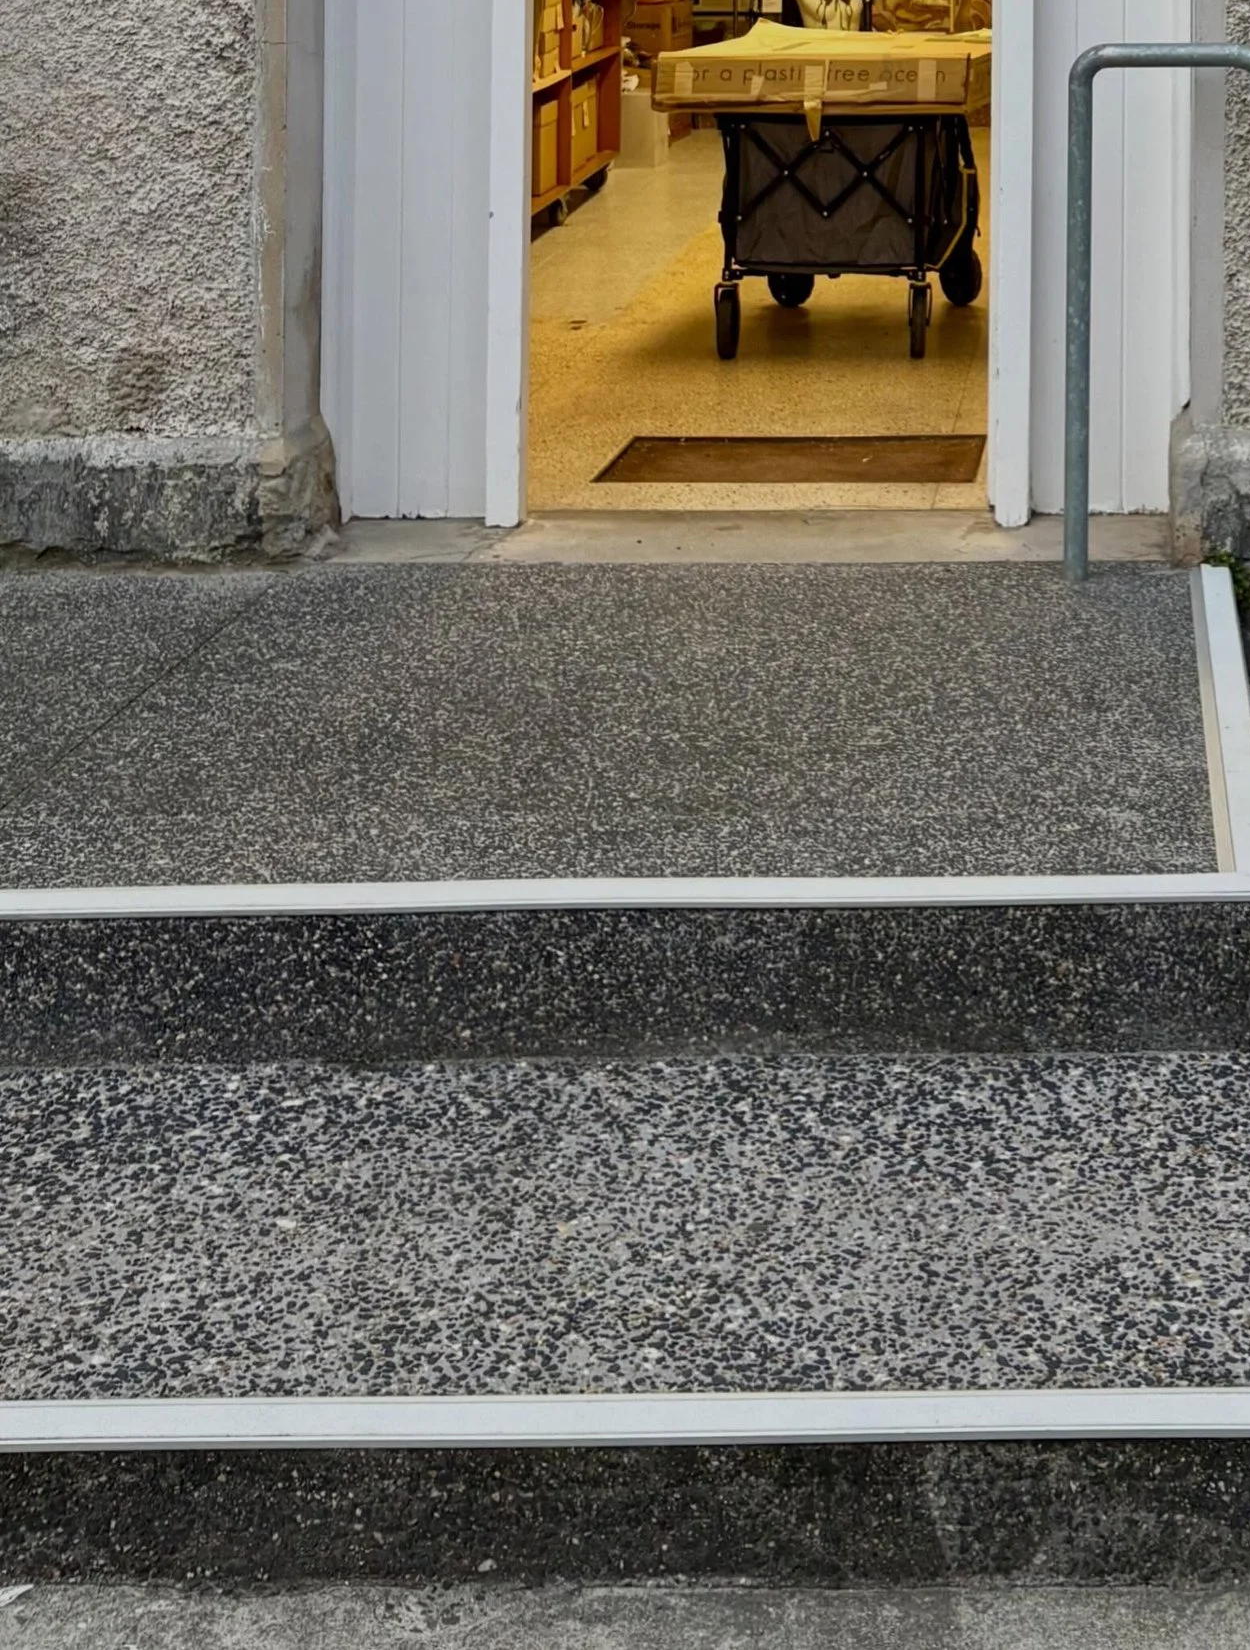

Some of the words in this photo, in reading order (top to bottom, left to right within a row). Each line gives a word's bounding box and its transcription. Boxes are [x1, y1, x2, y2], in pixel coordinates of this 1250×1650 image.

[719, 68, 732, 81] a
[742, 62, 805, 85] plasti
[878, 69, 946, 83] ocen
